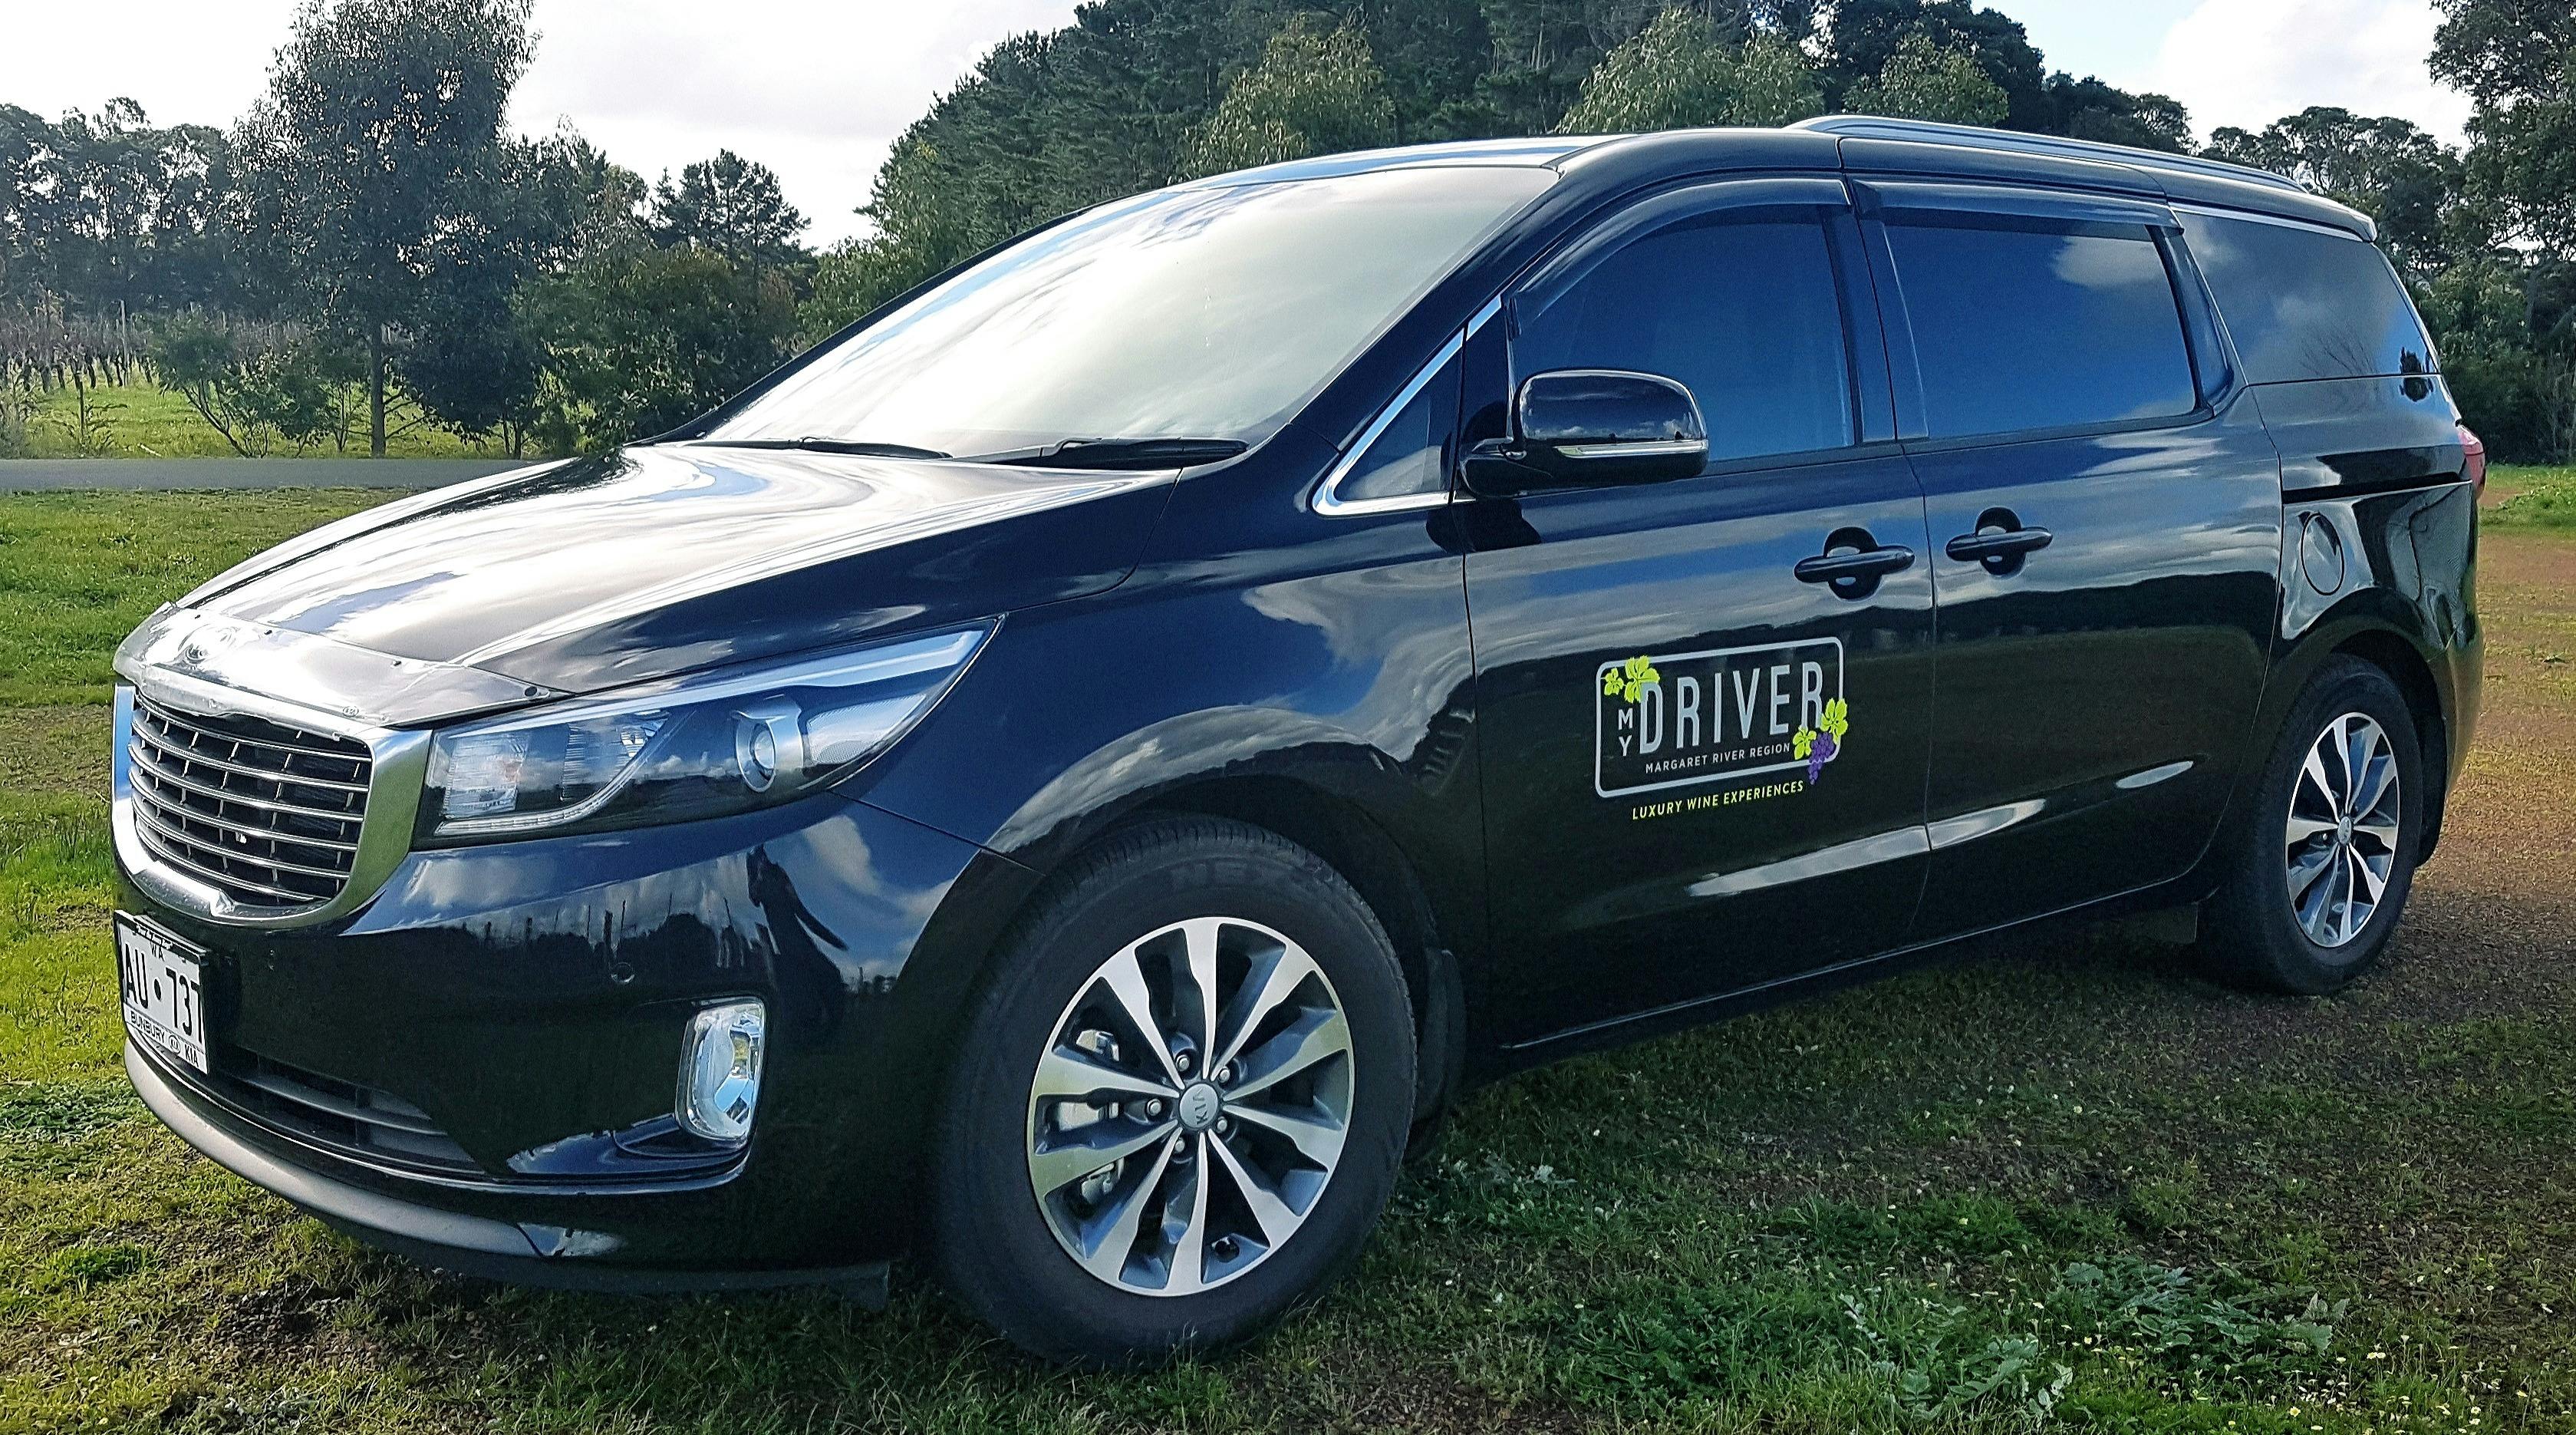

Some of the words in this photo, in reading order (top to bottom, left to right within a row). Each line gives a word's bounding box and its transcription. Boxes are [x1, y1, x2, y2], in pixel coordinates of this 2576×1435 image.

[1639, 661, 1823, 754] DRIVER
[1645, 754, 1708, 774] MARGARET
[1712, 749, 1745, 764] RIVER
[1750, 742, 1790, 757] REGION
[1632, 800, 1682, 820] LUXURY
[1687, 794, 1719, 810] WINE
[1723, 780, 1804, 805] EXPERIENCES
[130, 1010, 165, 1044] BUNBURY
[184, 1044, 199, 1068] KIA
